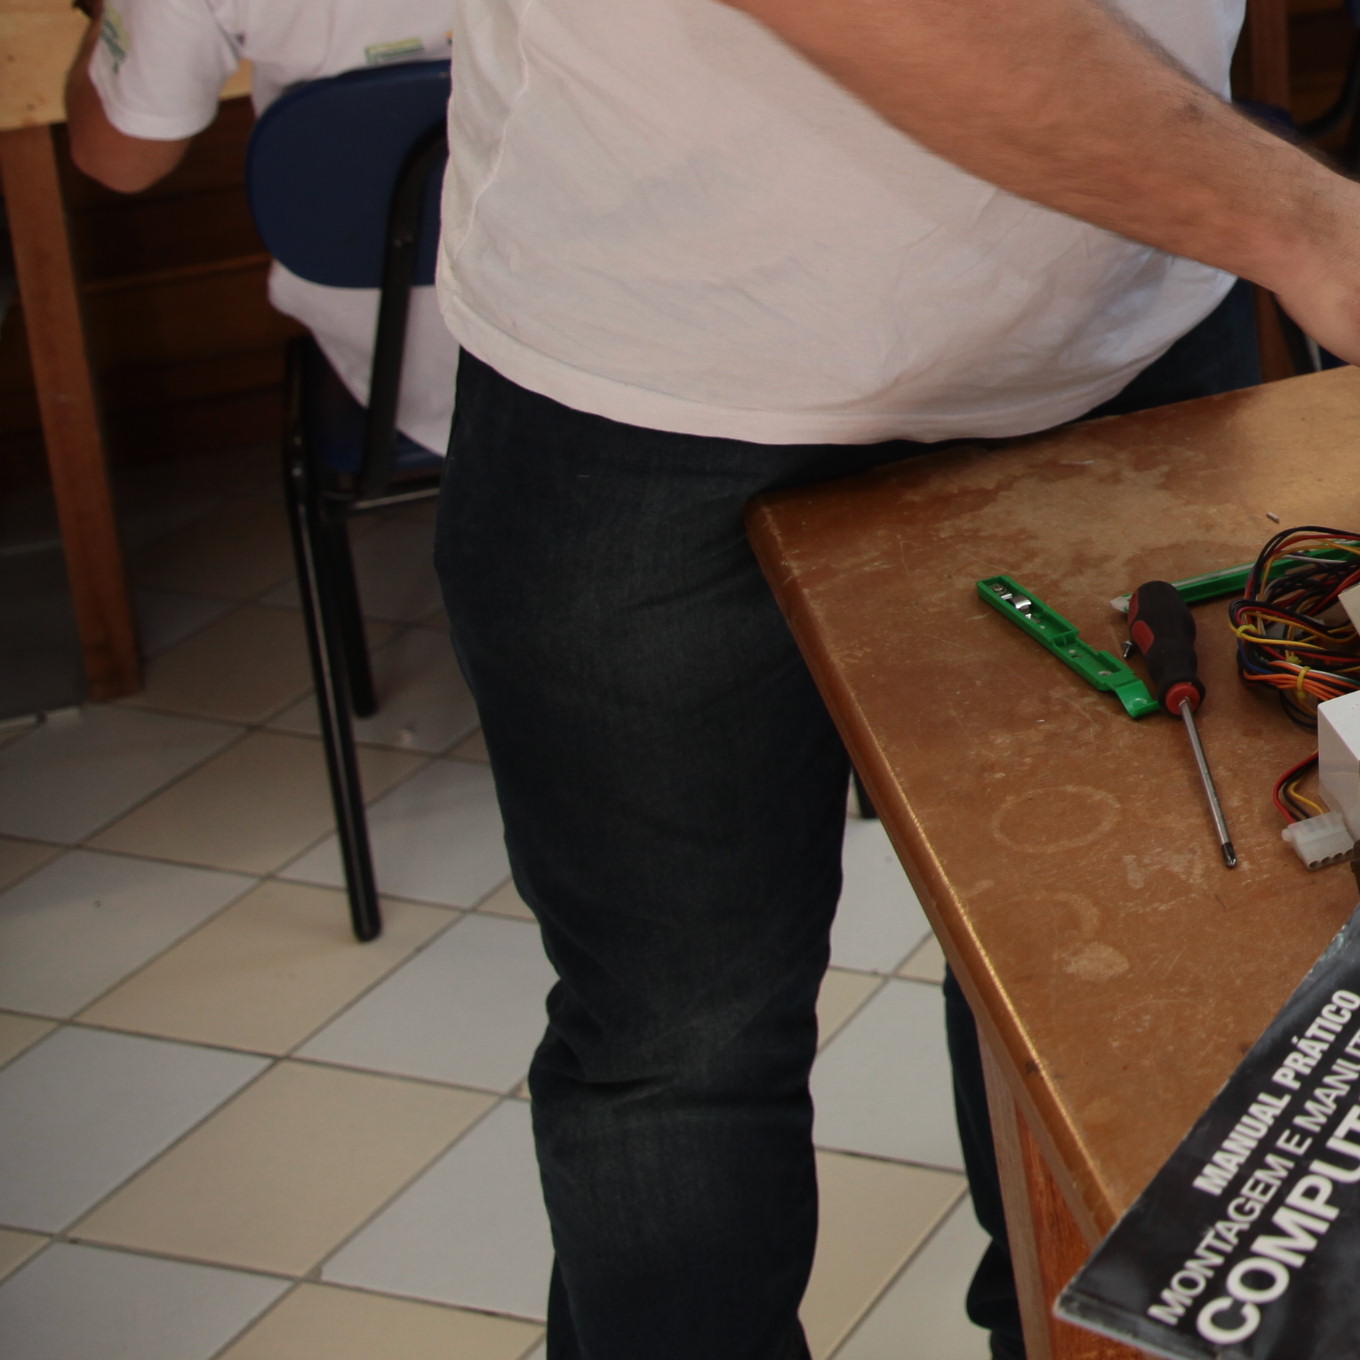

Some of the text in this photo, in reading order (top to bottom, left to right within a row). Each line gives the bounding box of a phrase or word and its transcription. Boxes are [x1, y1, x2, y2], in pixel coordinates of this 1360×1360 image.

[1193, 1092, 1291, 1197] MANUAL
[1148, 1146, 1295, 1327] MONTAGEM
[1275, 1128, 1313, 1157] E
